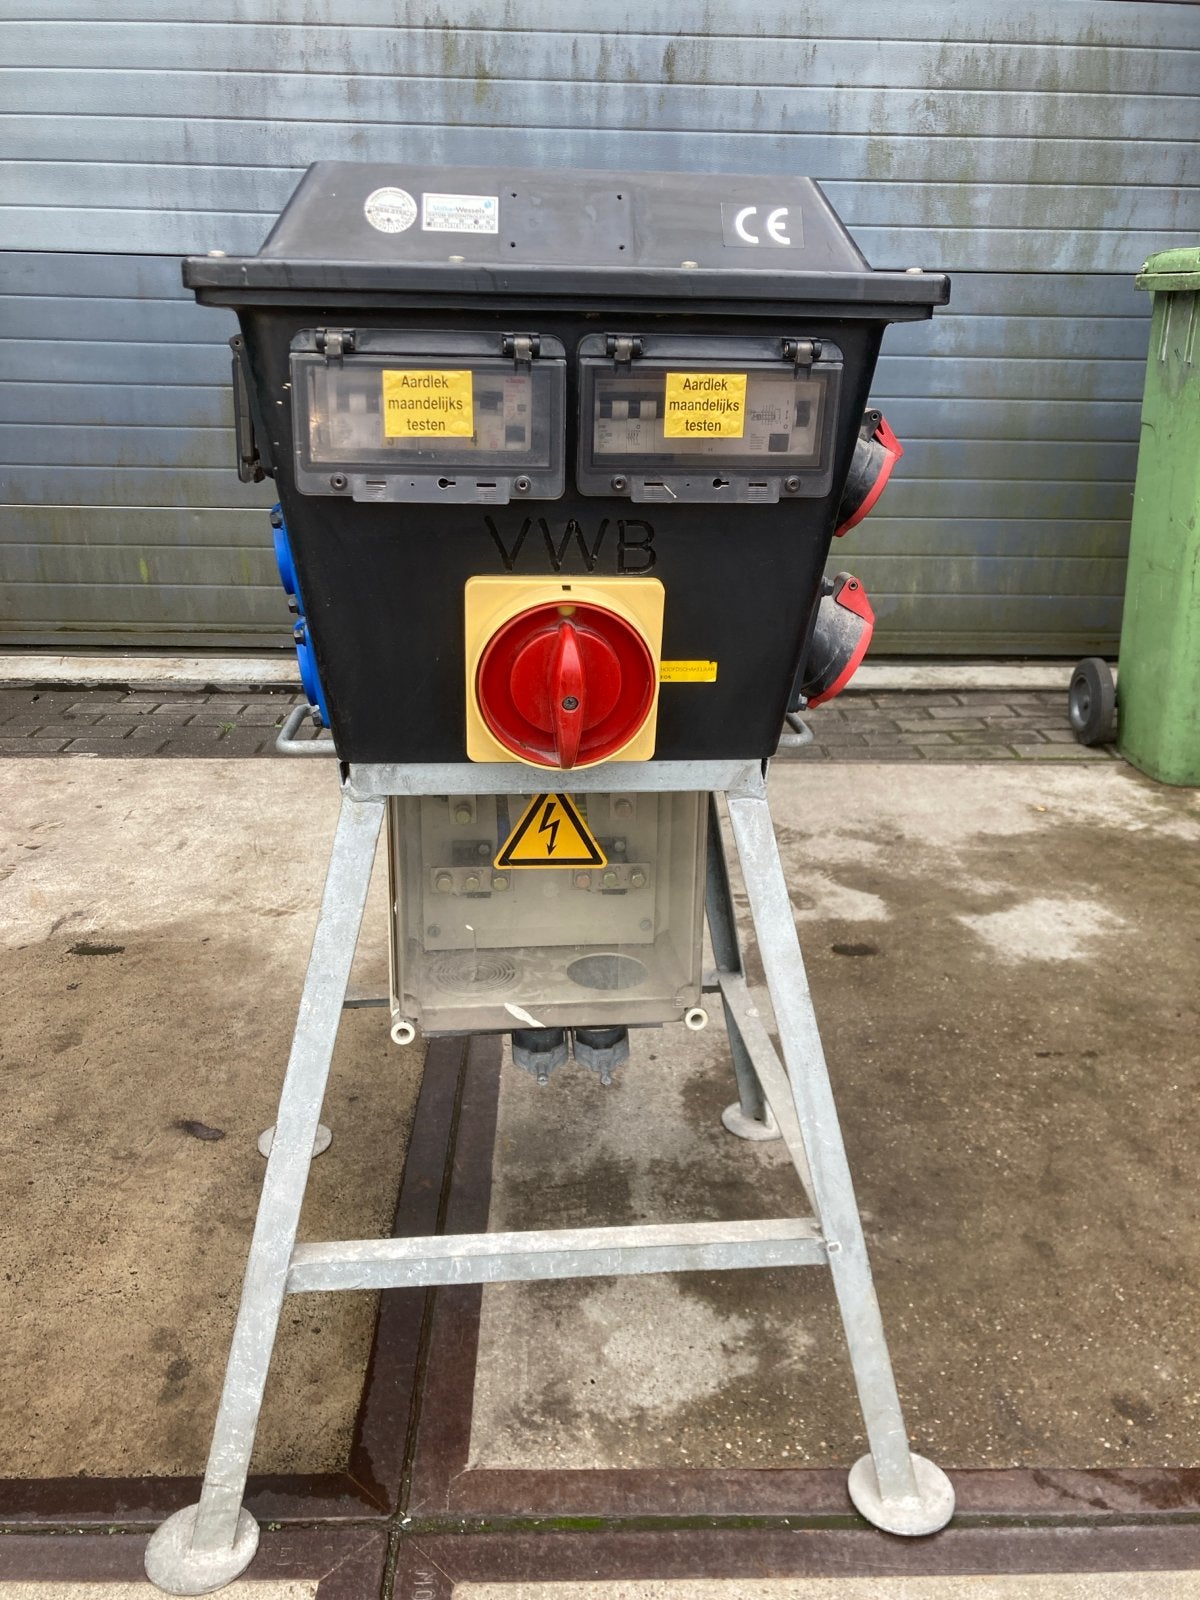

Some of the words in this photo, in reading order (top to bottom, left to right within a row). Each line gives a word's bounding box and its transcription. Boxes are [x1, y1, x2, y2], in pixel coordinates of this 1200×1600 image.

[735, 206, 791, 245] CE
[401, 375, 449, 389] Aardlek
[682, 378, 728, 391] Aardlek
[388, 396, 463, 412] maandelijks
[669, 399, 740, 415] maandelijks
[406, 419, 446, 432] testen
[685, 420, 722, 432] testen
[484, 515, 657, 575] VWB
